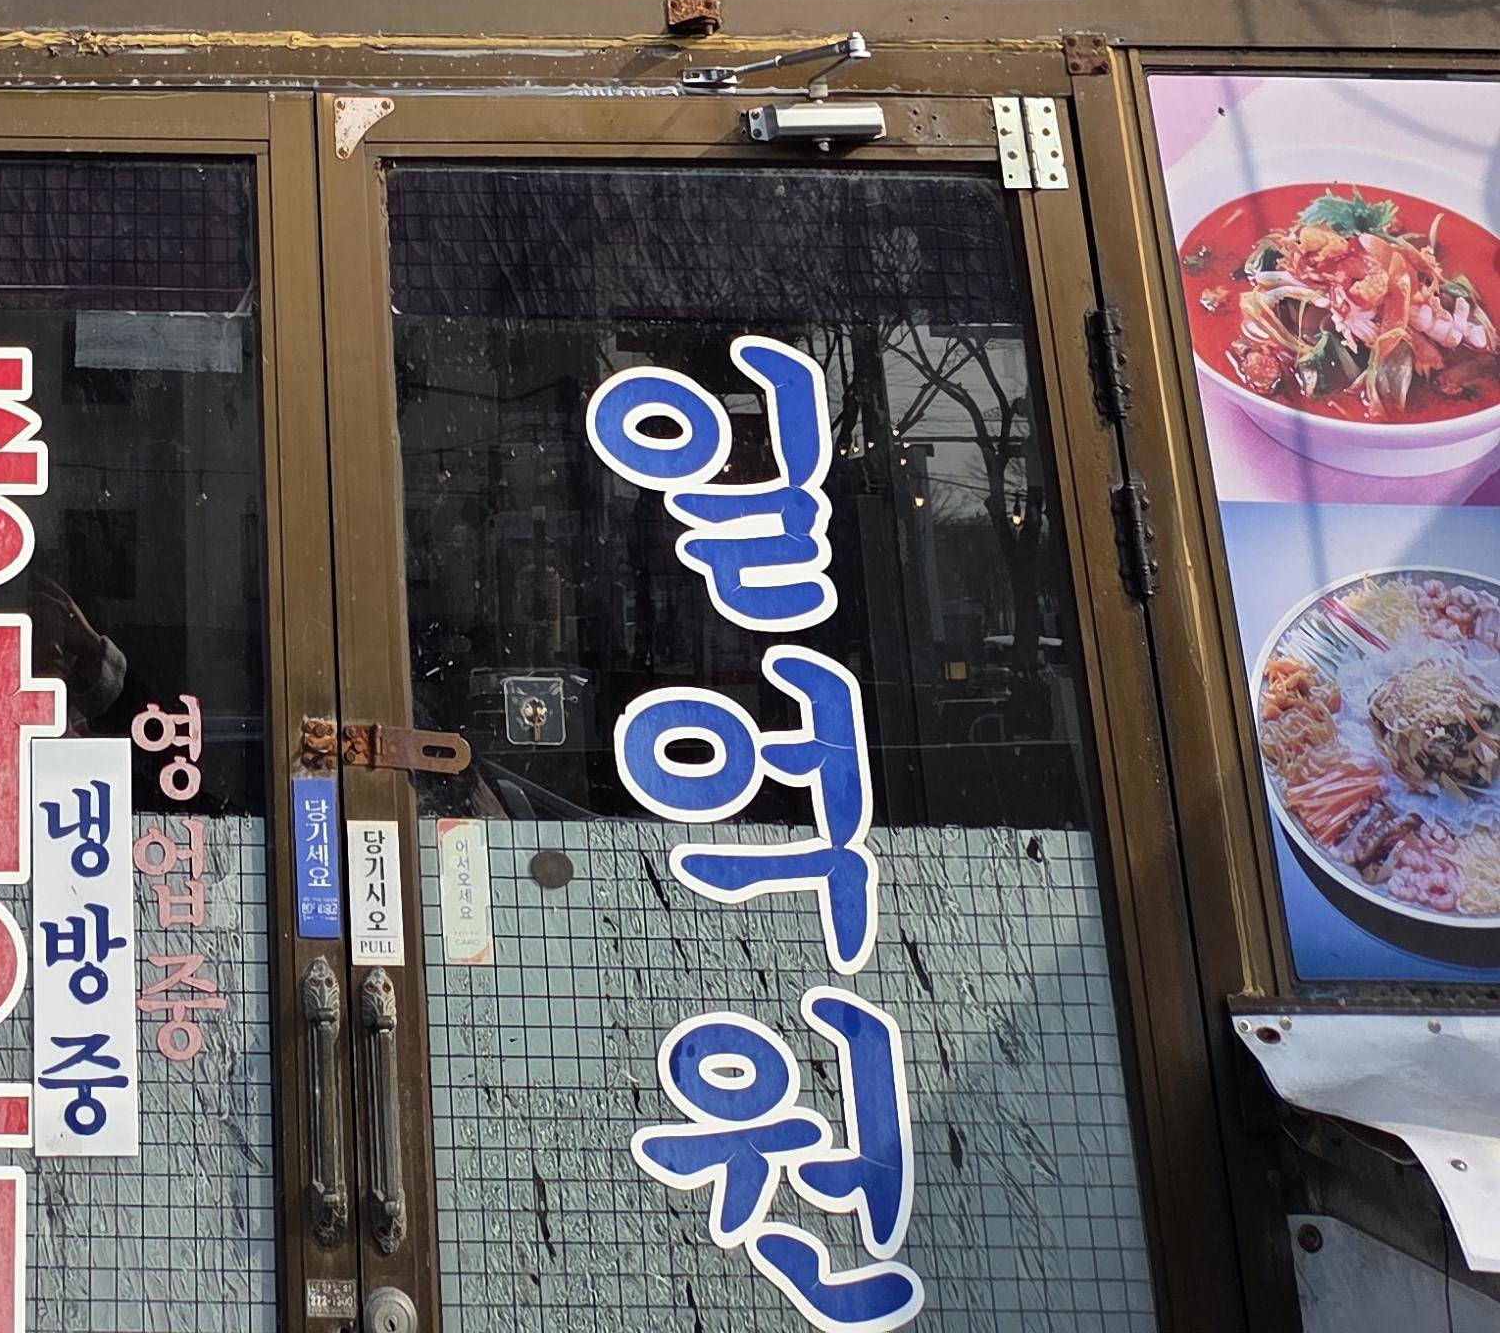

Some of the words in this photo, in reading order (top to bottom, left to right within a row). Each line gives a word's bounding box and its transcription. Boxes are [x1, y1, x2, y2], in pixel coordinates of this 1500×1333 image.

[130, 693, 226, 1063] 영업중
[304, 799, 332, 887] 당기세요
[363, 829, 389, 932] 당기시오
[455, 837, 475, 920] 어서오세요
[584, 334, 925, 1333] 일억원
[36, 779, 130, 1137] 냉방중
[360, 939, 396, 954] PULL
